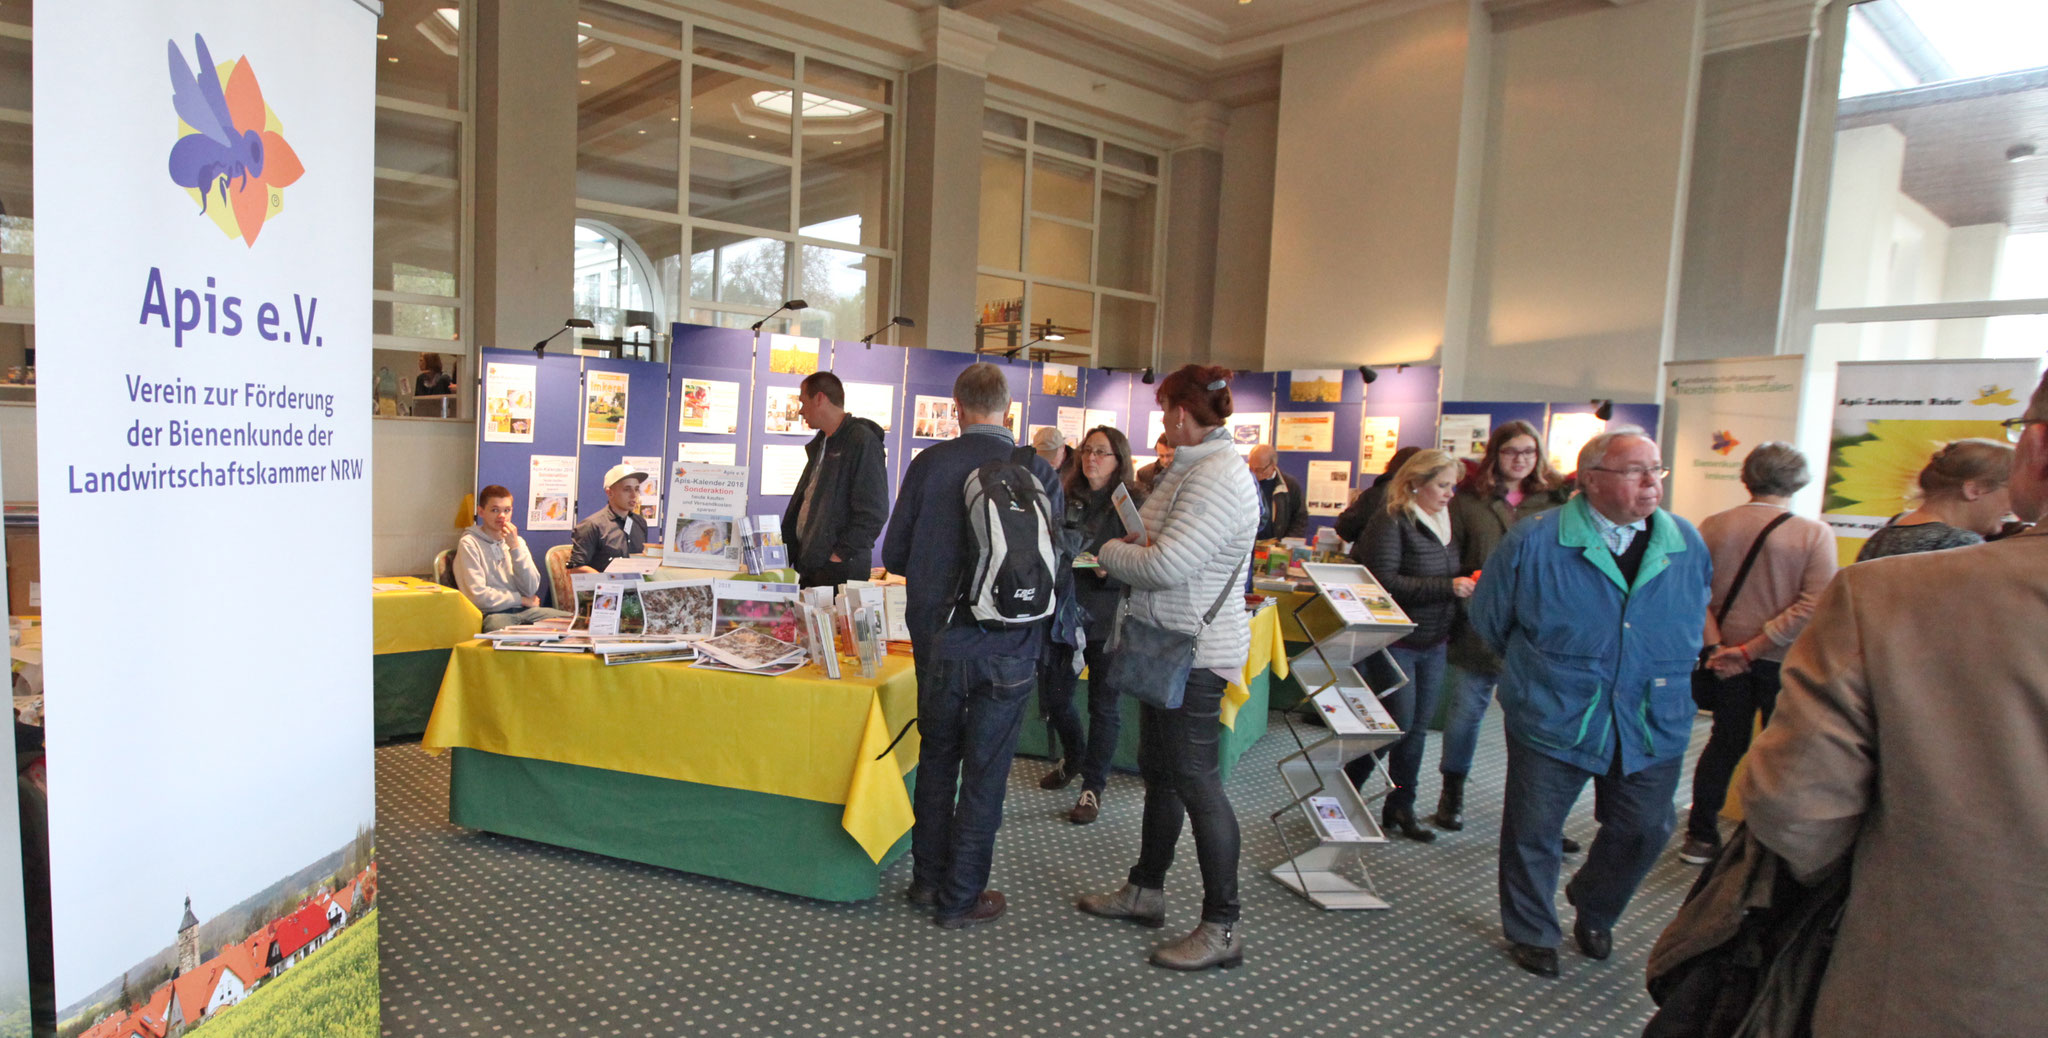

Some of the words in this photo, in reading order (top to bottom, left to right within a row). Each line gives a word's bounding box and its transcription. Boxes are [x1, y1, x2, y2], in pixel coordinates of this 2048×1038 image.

[139, 266, 243, 348] Apis
[257, 293, 323, 348] e.V.
[126, 374, 197, 405] Verein
[204, 387, 239, 406] zur
[245, 383, 334, 417] Förderung
[590, 381, 625, 393] Imkerei
[1839, 397, 1924, 407] Api-Zentrum
[1929, 397, 1963, 406] Ruhr
[127, 419, 163, 447] der
[169, 420, 303, 447] Bienenkunde
[308, 423, 334, 446] der
[68, 460, 326, 494] Landwirtschaftskammer
[330, 458, 363, 481] NRW
[674, 477, 725, 486] Apis-Kalender
[727, 480, 744, 488] 2018
[684, 485, 734, 494] Sonderaktion
